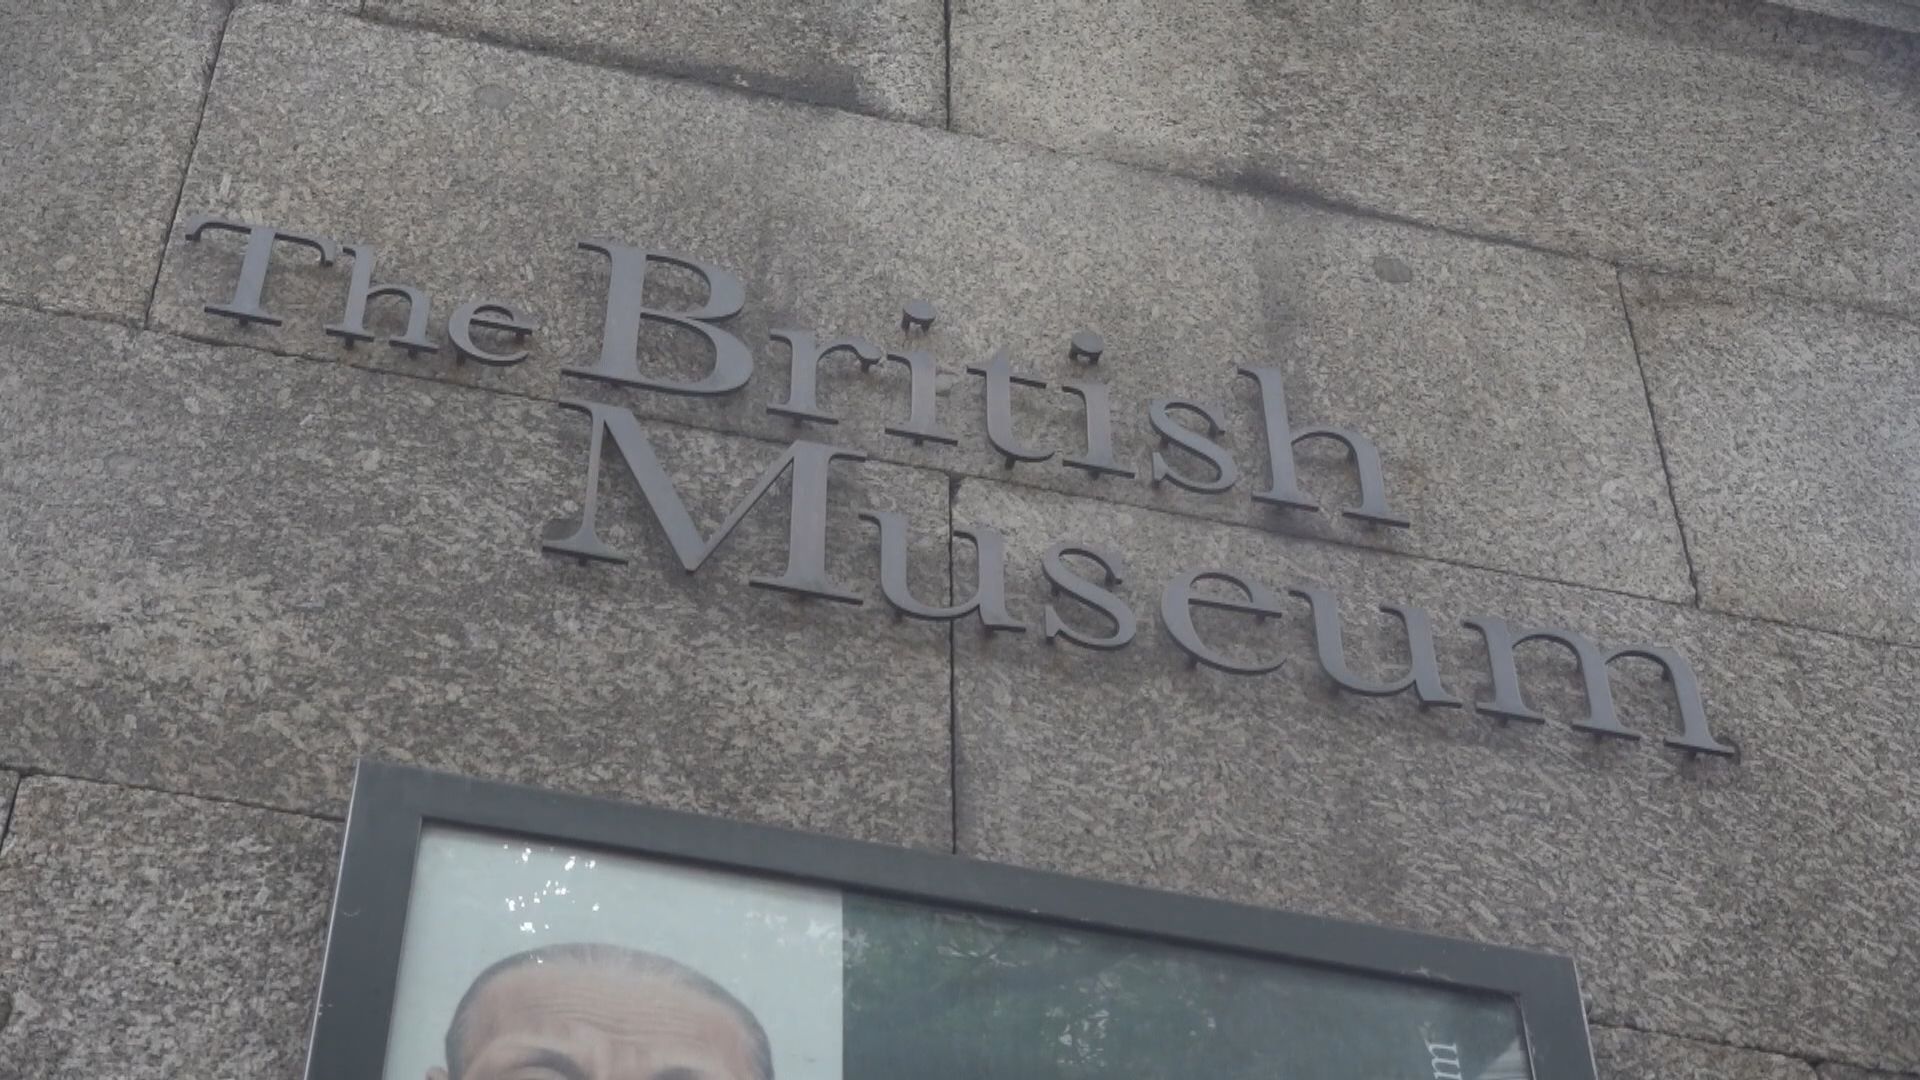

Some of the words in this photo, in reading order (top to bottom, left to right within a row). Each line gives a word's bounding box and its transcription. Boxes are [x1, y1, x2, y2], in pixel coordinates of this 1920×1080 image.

[185, 221, 533, 364] The
[561, 239, 1410, 527] British
[544, 402, 1737, 755] Museum
